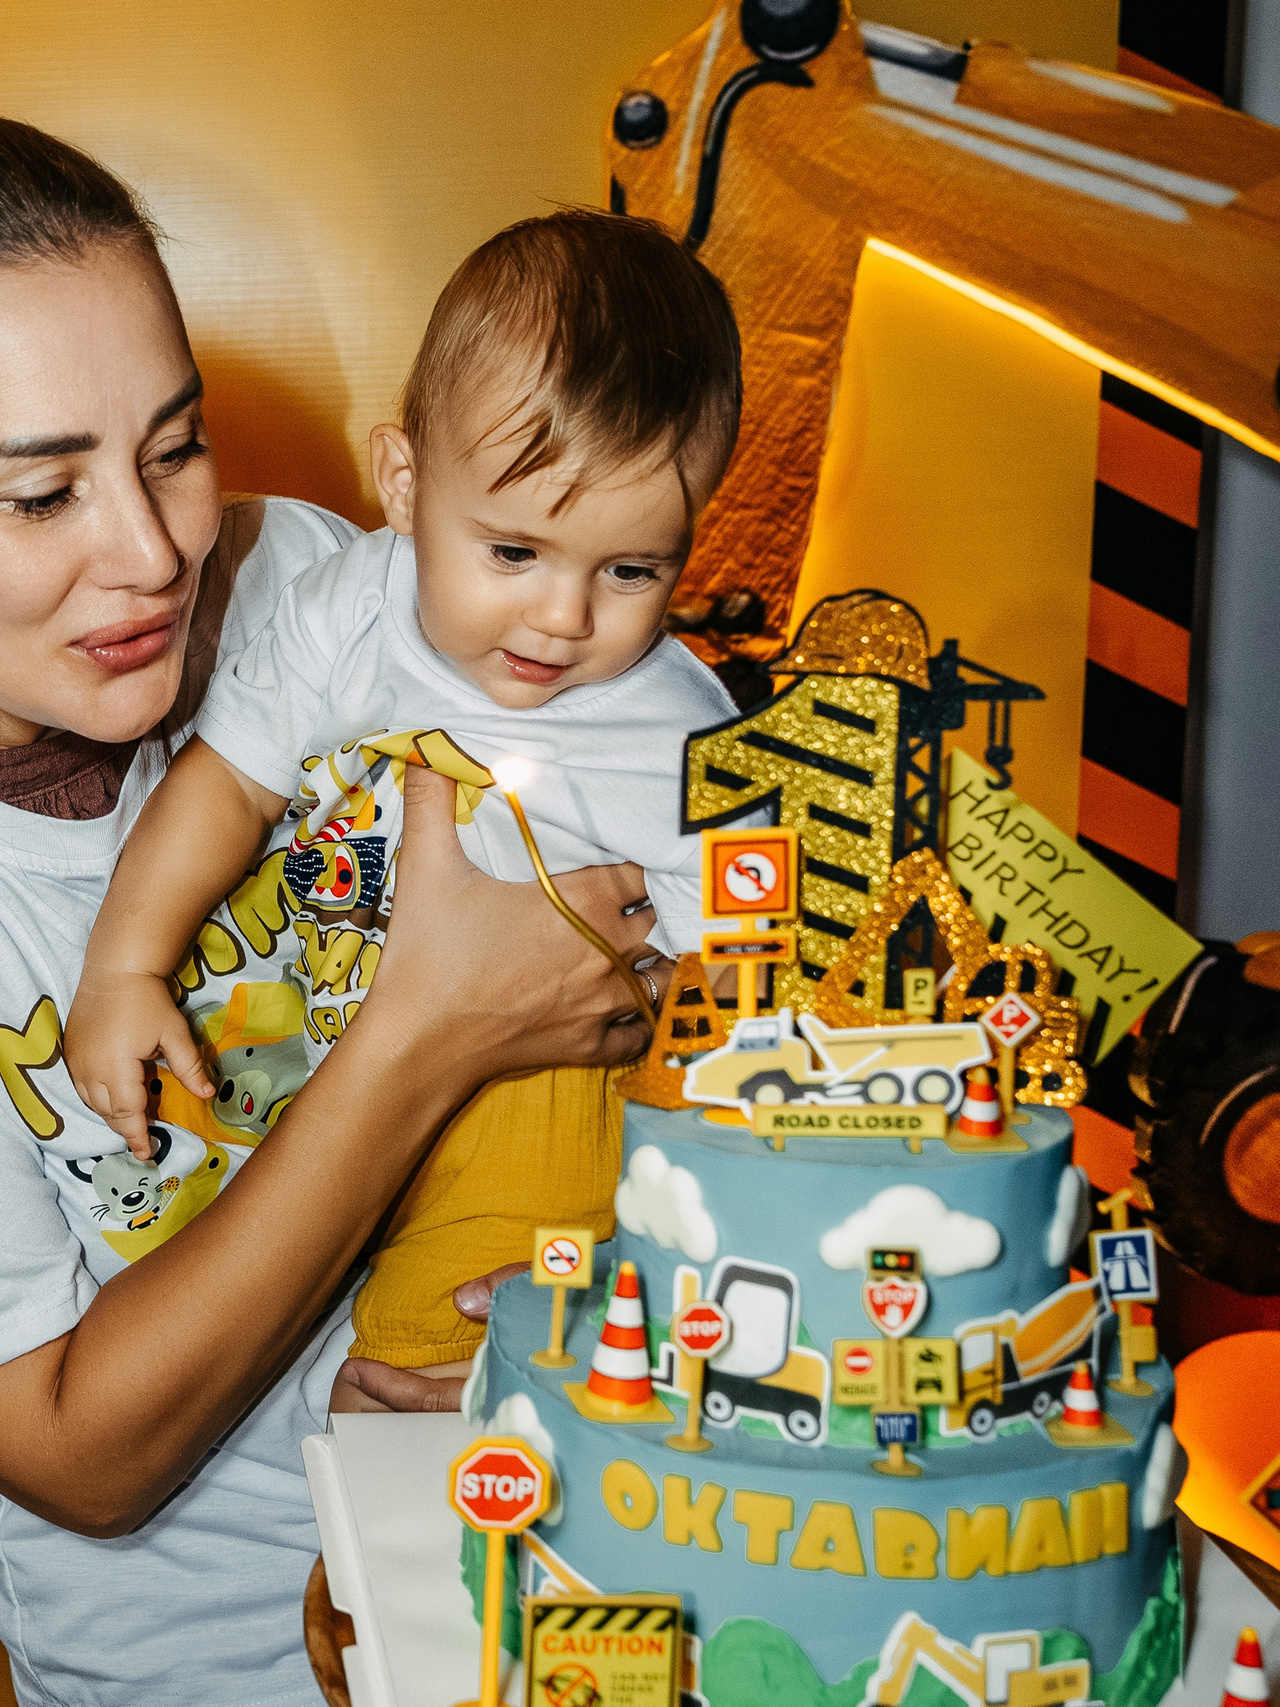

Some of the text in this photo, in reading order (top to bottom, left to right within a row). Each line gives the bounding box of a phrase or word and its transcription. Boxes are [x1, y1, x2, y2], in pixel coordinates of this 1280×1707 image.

[948, 780, 1085, 884] HAPPY
[947, 832, 1160, 1003] BIRTHDAY!
[772, 1114, 922, 1130] ROAD CLOSED
[679, 1320, 721, 1337] STOP
[462, 1472, 534, 1502] STOP
[600, 1458, 1130, 1581] ОКТАВИАН
[541, 1634, 666, 1657] CAUTION
